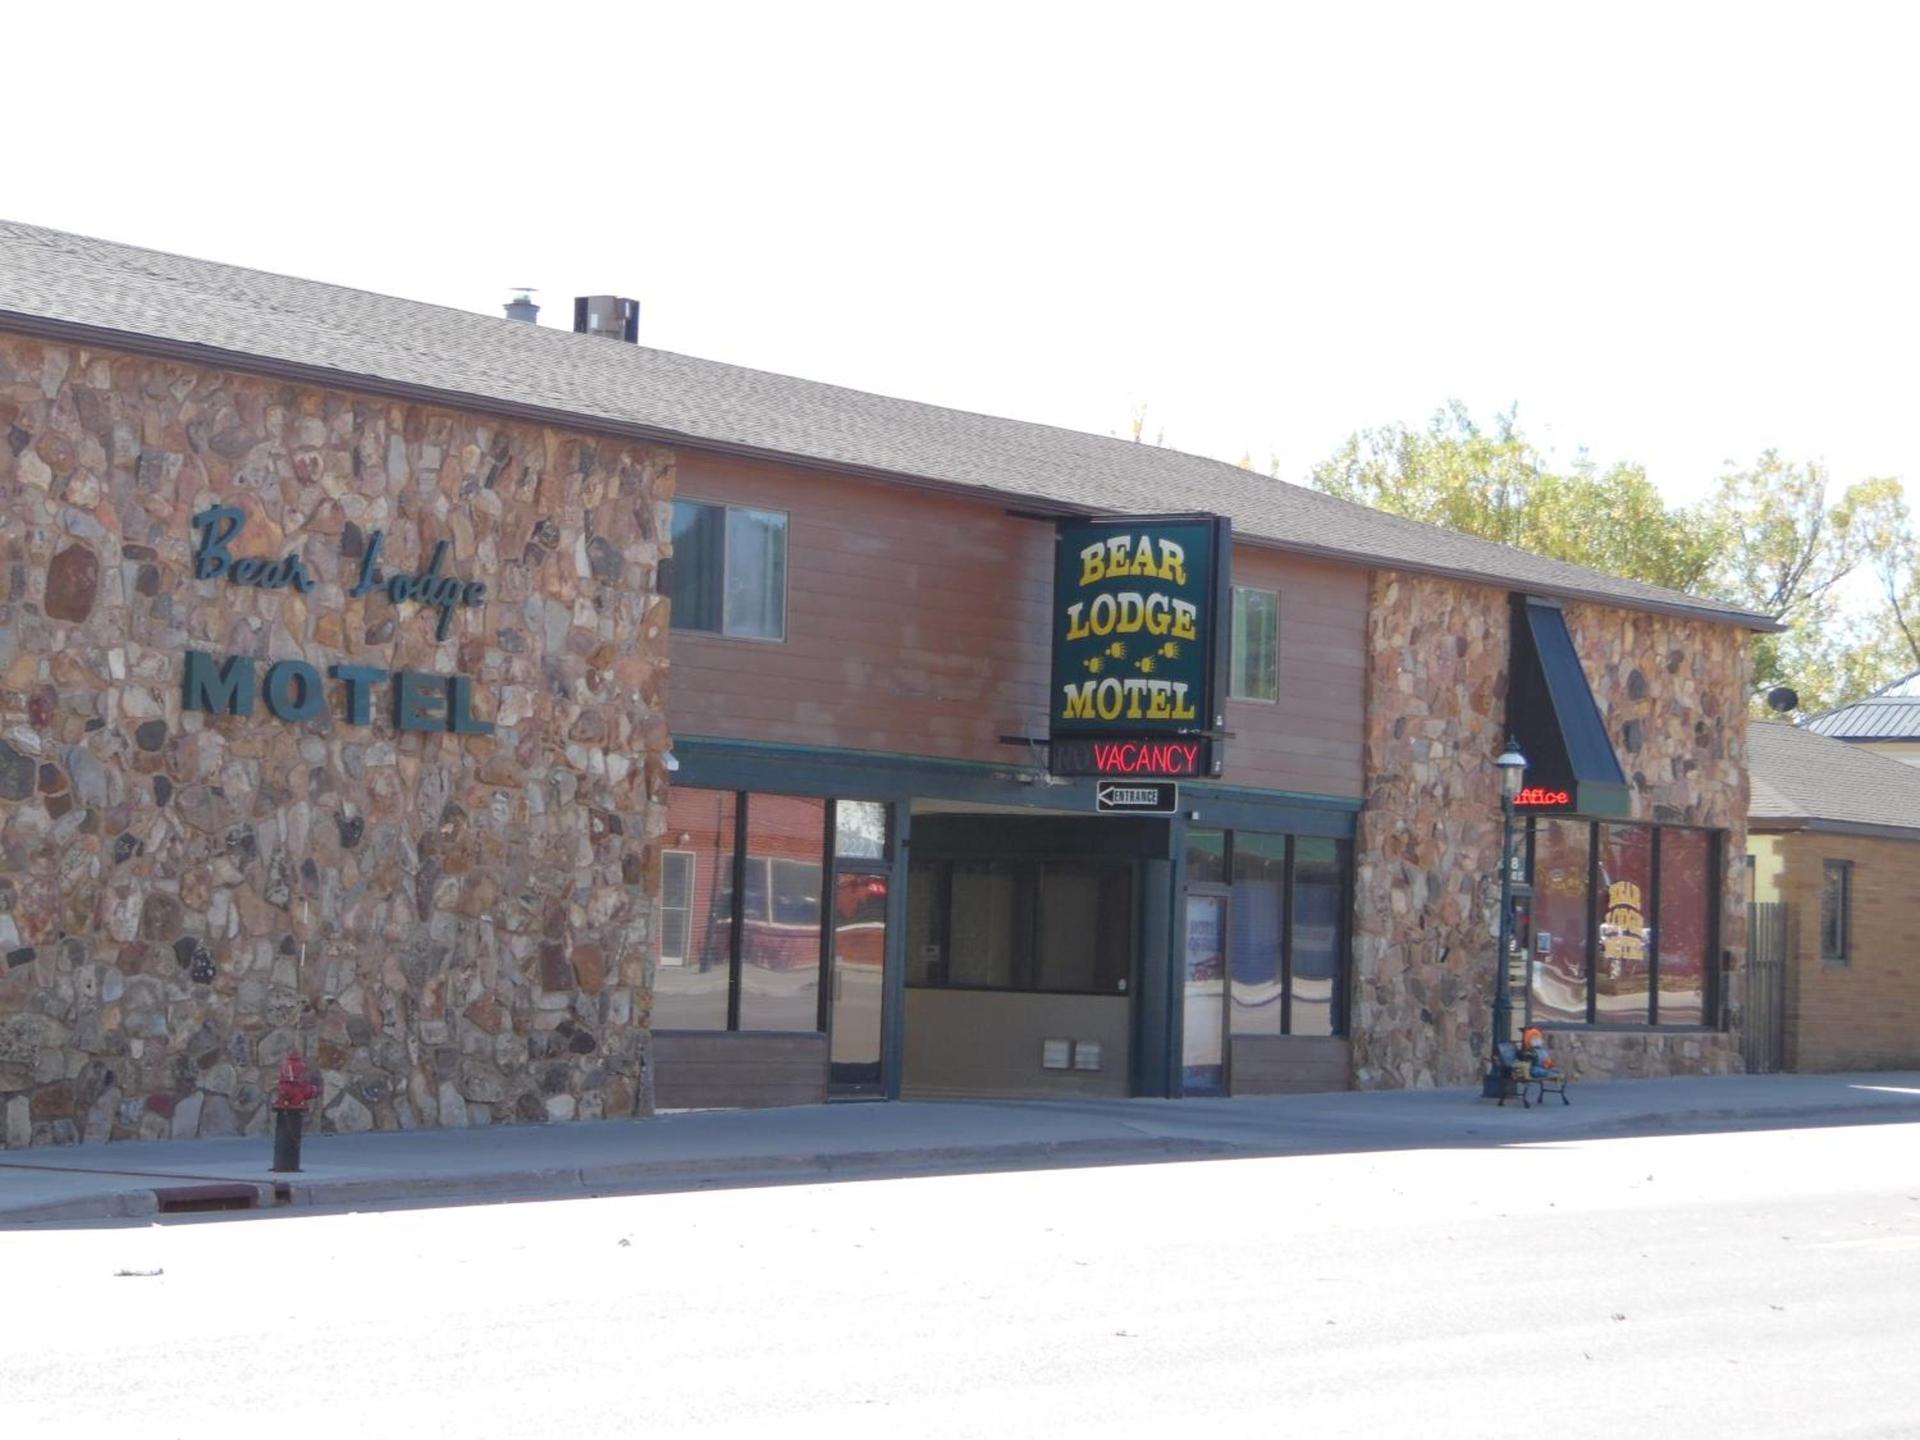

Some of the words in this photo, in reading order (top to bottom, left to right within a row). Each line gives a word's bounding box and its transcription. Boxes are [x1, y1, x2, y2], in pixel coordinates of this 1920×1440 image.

[193, 504, 315, 593] Bear
[349, 530, 487, 642] Lodge
[1079, 535, 1186, 586] BEAR
[1066, 592, 1197, 641] LODGE
[182, 650, 495, 735] MOTEL
[1062, 677, 1196, 721] MOTEL
[1094, 743, 1198, 774] VACANCY
[1114, 789, 1158, 804] ENTRANCE
